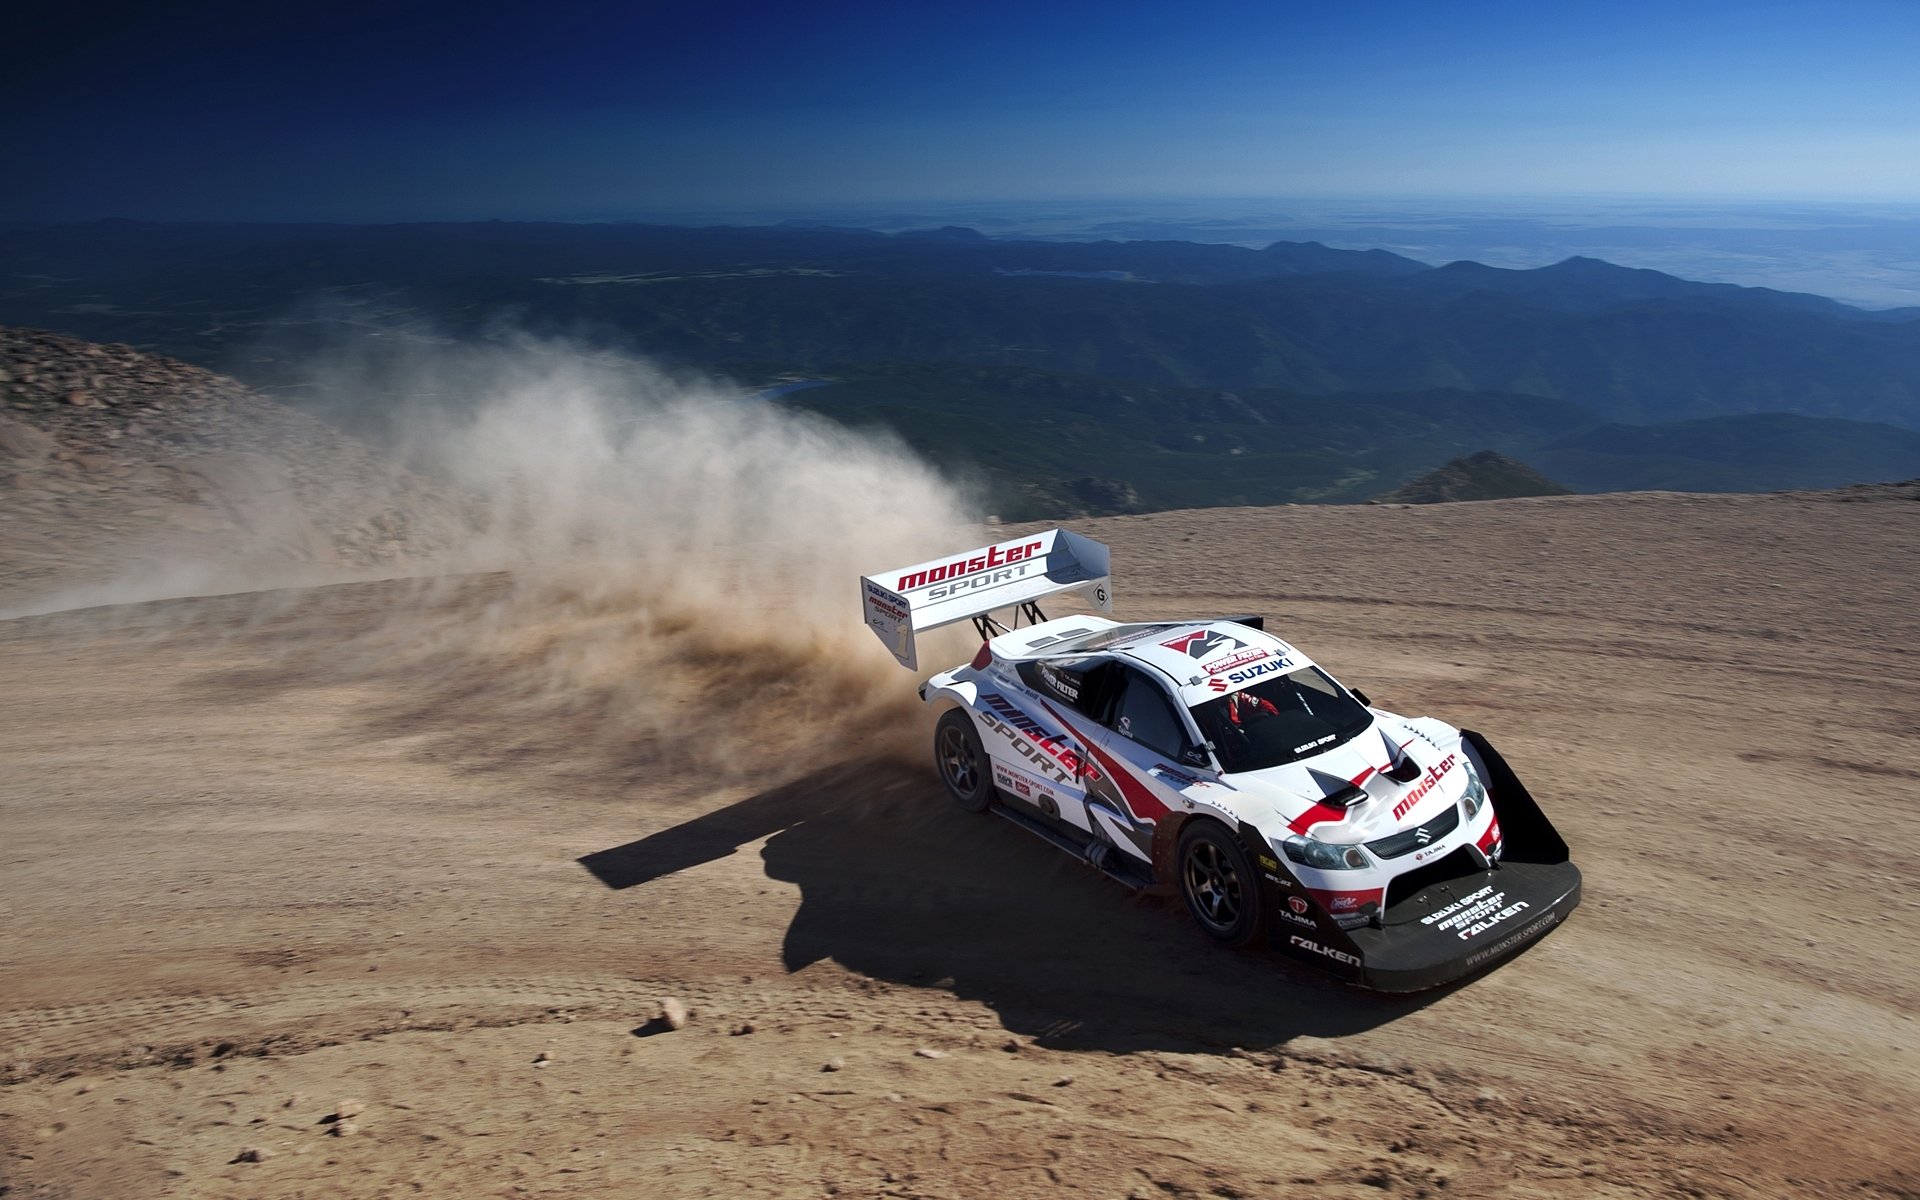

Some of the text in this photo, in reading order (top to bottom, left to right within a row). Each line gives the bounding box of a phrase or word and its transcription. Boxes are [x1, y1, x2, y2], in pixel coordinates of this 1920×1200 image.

[897, 541, 1042, 592] monster
[928, 563, 1031, 601] SPORT
[1096, 588, 1105, 602] G
[868, 596, 909, 620] monster
[873, 605, 903, 624] SPORT
[887, 594, 908, 610] SPORT
[1204, 647, 1267, 673] POWER FILTER
[1228, 658, 1294, 685] SUZUKI
[1056, 680, 1079, 700] FILTER
[978, 710, 1073, 784] SPORT
[979, 693, 1103, 782] monster
[1293, 733, 1337, 754] SUZUKI SPORT
[1392, 753, 1456, 822] monster
[1279, 909, 1318, 929] TAJIMA
[1420, 885, 1494, 926] SUZUKI SPORT
[1437, 892, 1506, 932] monster
[1454, 901, 1503, 930] SPORT
[1457, 901, 1530, 940] FALKEN
[1289, 934, 1362, 968] FALKEN
